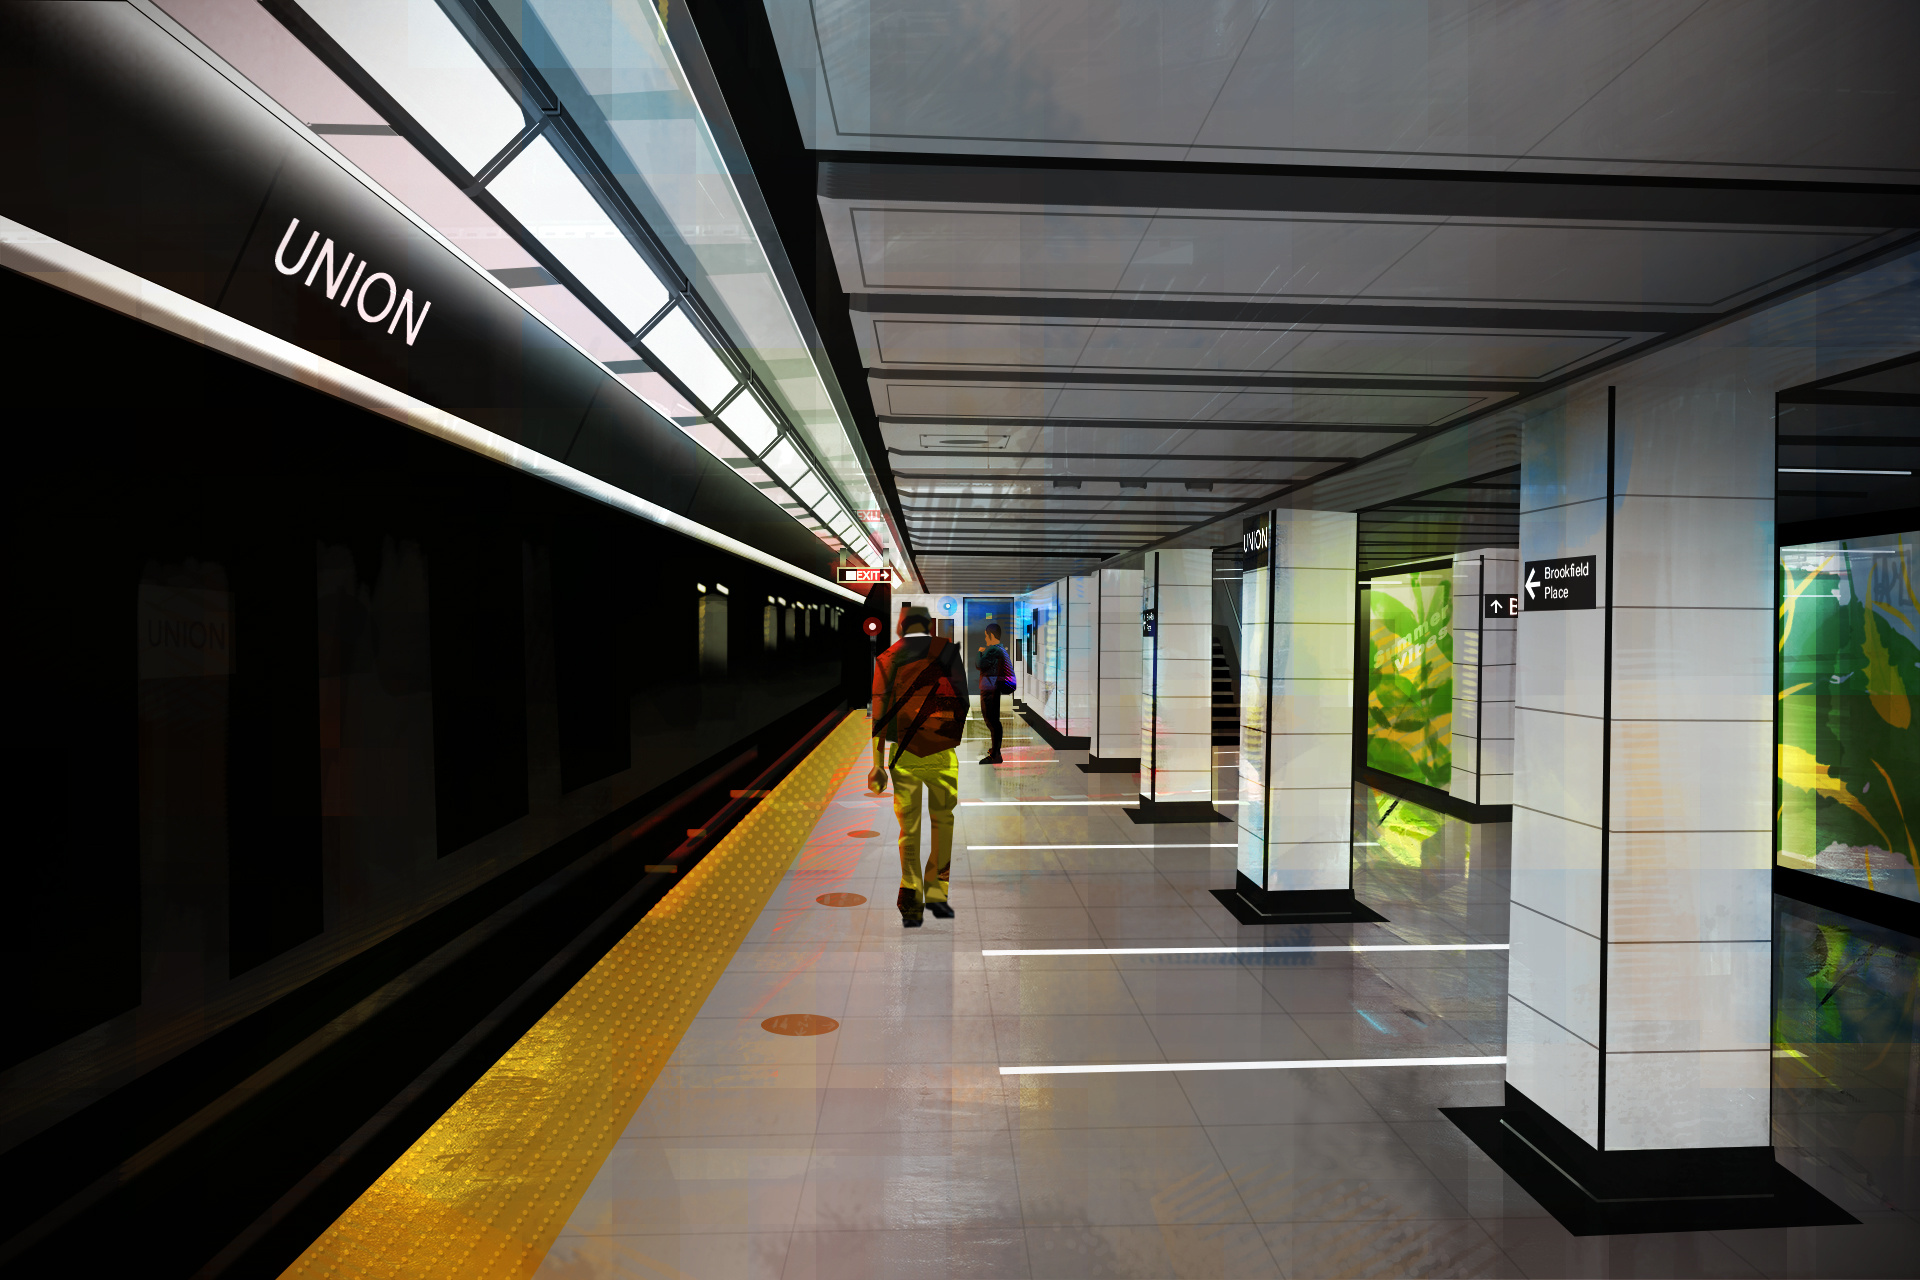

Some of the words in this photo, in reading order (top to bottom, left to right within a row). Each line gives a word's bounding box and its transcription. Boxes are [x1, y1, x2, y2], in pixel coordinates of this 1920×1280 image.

[275, 217, 432, 347] UNION
[1243, 527, 1268, 553] UNION
[857, 570, 880, 580] EXIT
[1544, 562, 1589, 580] Brookfield
[1544, 586, 1569, 600] Place
[148, 619, 225, 649] UNION
